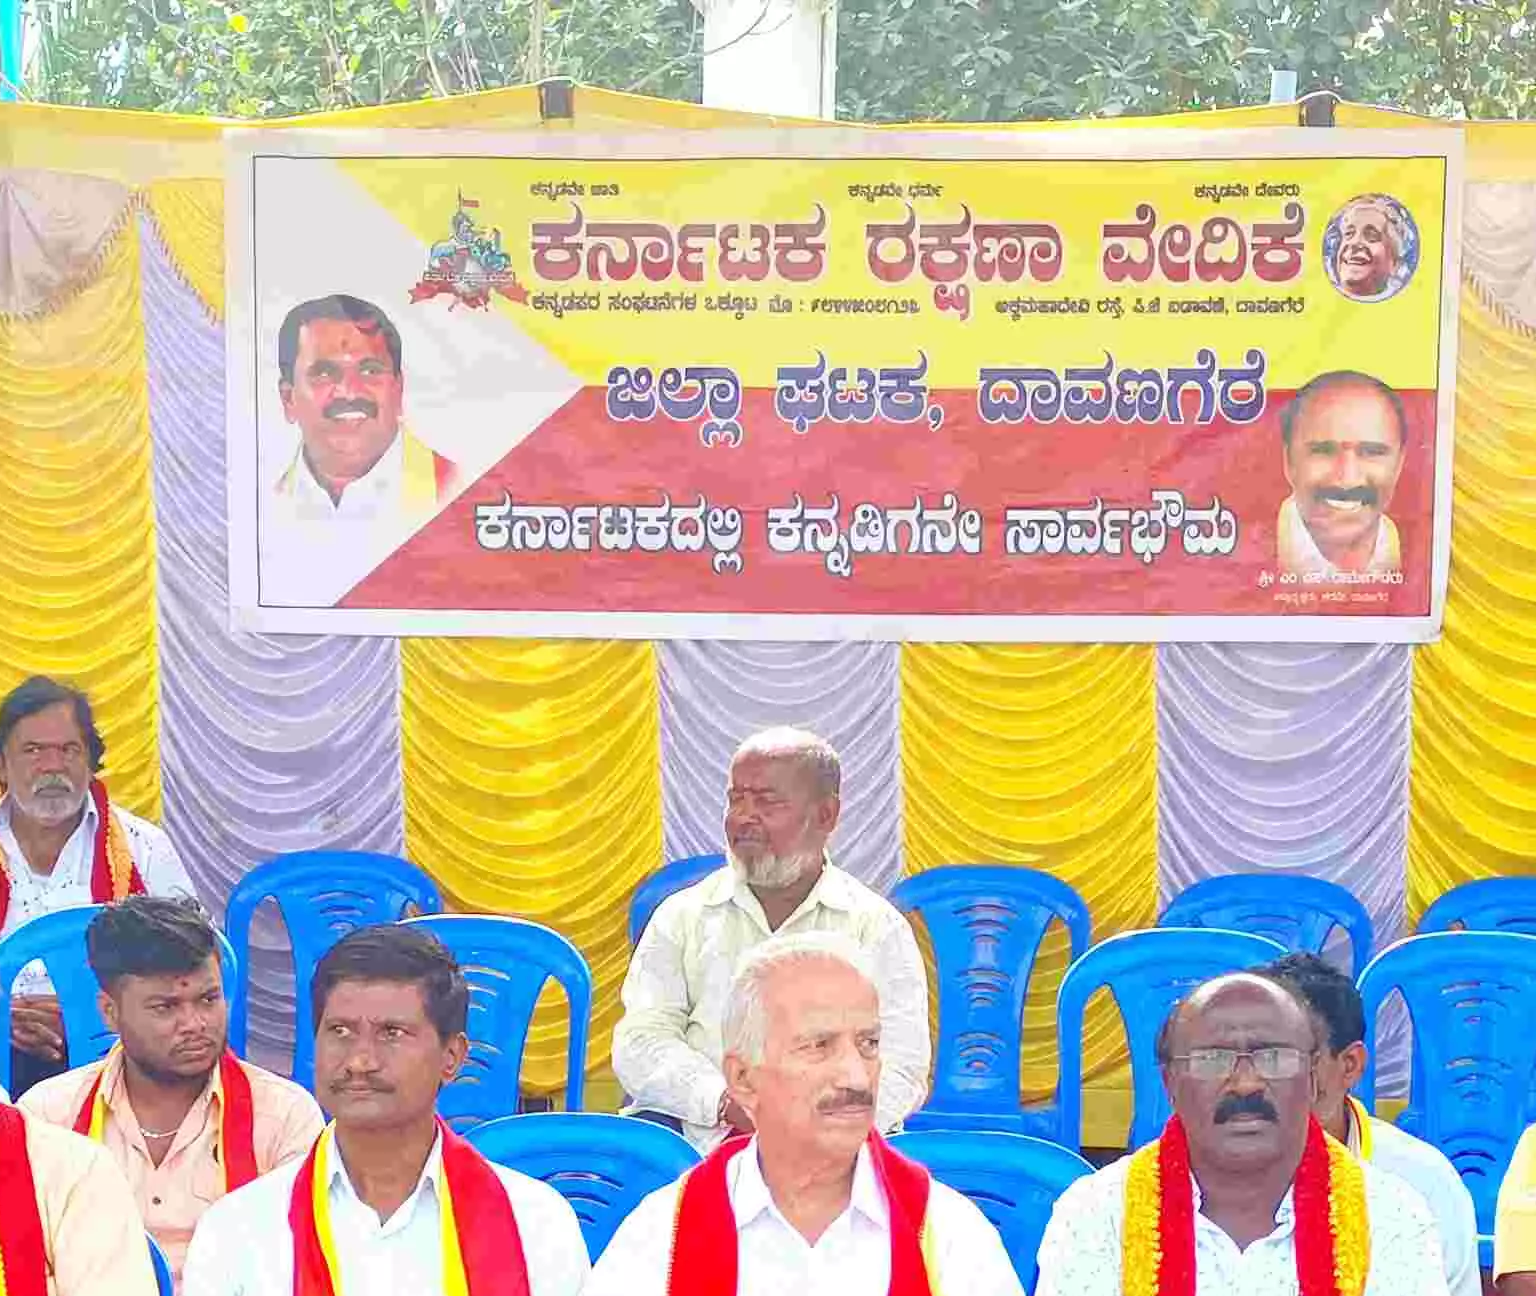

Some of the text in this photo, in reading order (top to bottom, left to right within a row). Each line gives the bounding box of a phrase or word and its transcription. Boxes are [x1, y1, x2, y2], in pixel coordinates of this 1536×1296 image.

[530, 200, 1305, 321] ಕರ್ನಾಟಕ ರಕ್ಷಣಾ ವೇದಿಕೆ
[1236, 296, 1305, 314] ದಾವಣಗೆರೆ
[606, 347, 1265, 448] ಜಿಲ್ಲಾ ಘಟಕ, ದಾವಣಗೆರೆ
[474, 489, 1238, 577] ಕರ್ನಾಟಕದಲ್ಲಿ ಕನ್ನಡಿಗನೇ ಸಾರ್ವಭೌಮ
